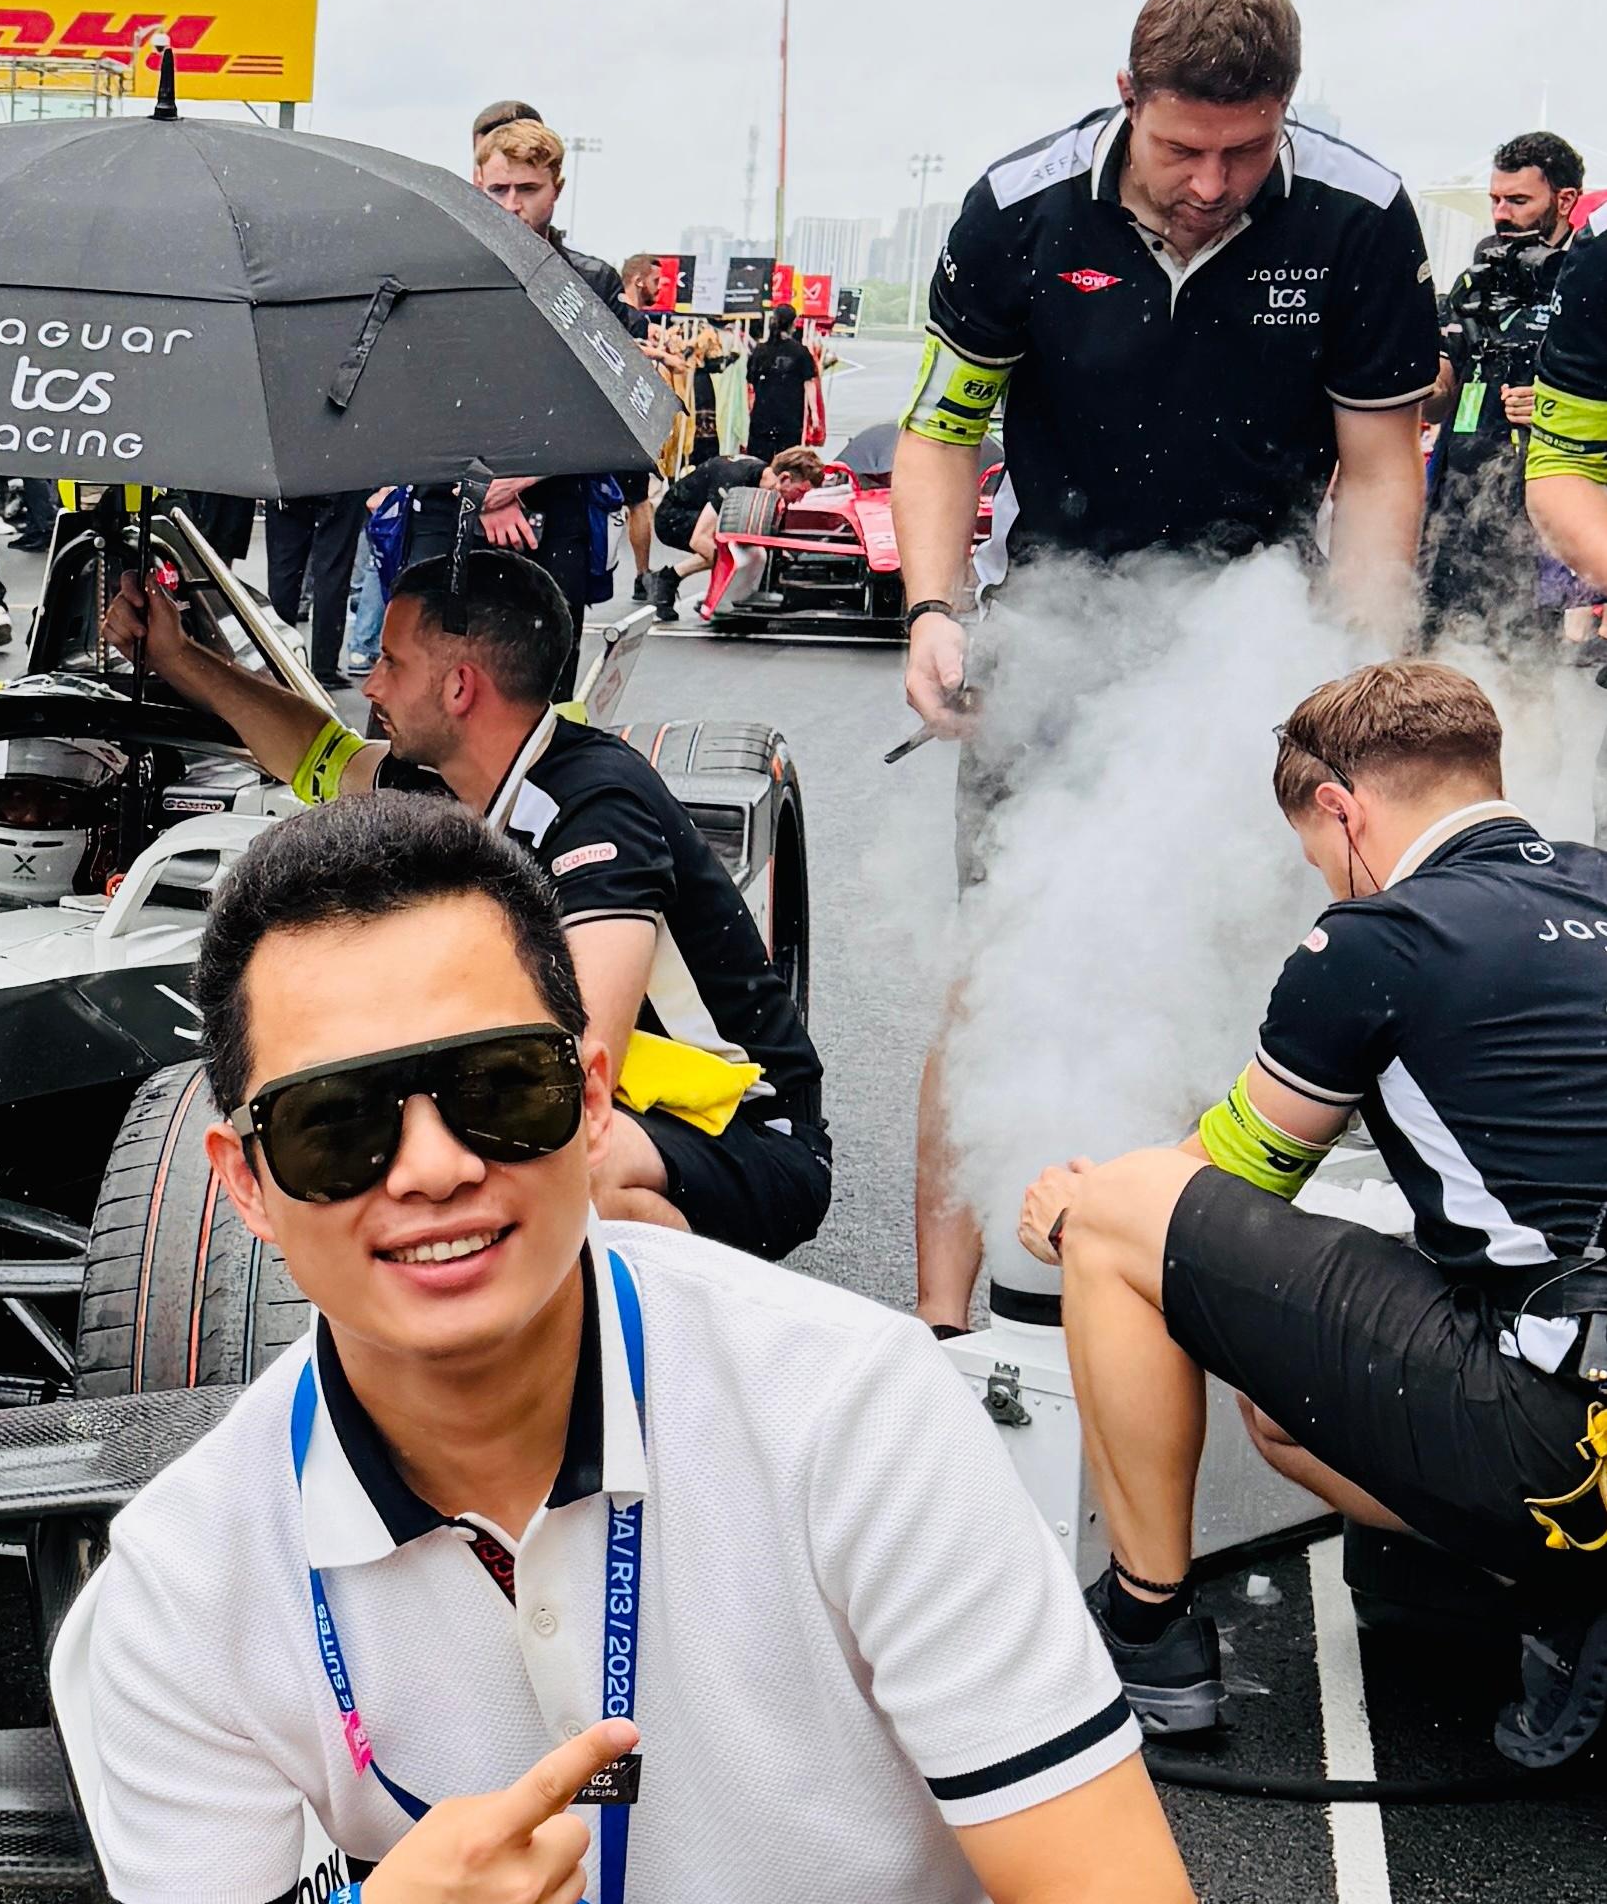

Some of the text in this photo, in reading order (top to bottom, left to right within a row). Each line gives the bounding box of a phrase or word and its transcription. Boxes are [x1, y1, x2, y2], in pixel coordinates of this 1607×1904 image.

[1071, 271, 1109, 286] DOW
[1268, 284, 1307, 309] tcs
[10, 355, 115, 415] tcs
[609, 1561, 635, 1615] R13
